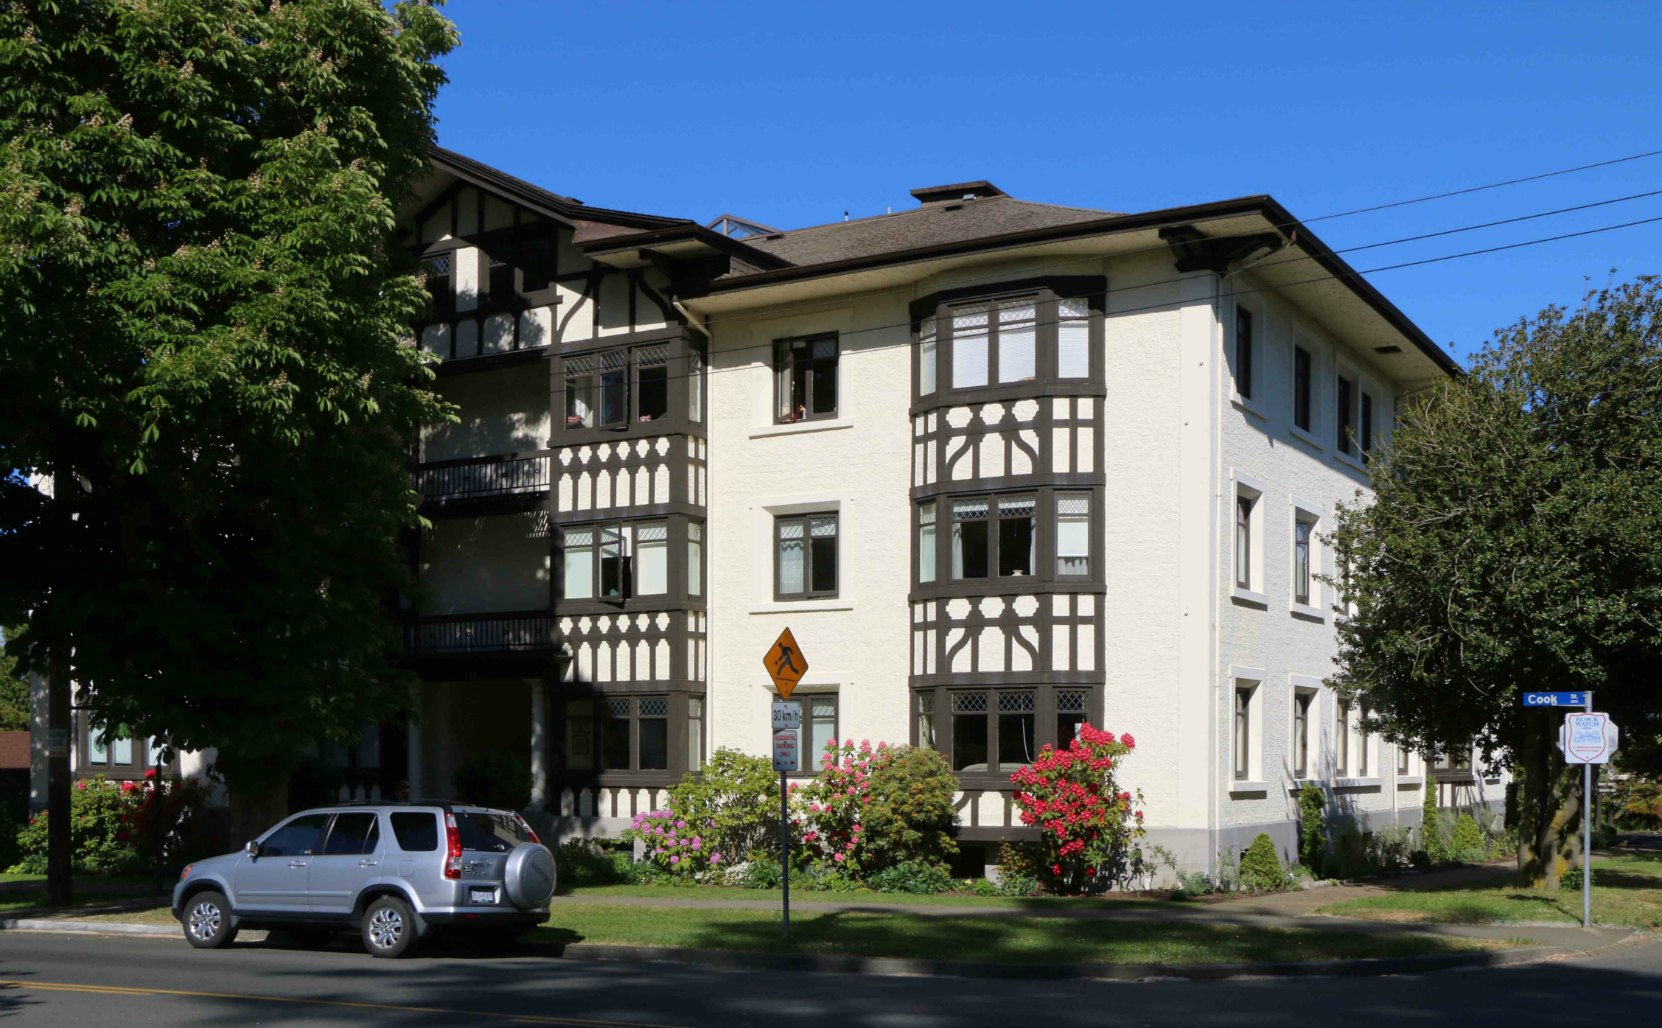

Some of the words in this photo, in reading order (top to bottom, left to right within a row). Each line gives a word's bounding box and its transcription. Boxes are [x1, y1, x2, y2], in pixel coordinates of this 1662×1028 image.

[1527, 694, 1558, 704] Cook
[773, 709, 781, 722] 30
[782, 709, 799, 722] km/h
